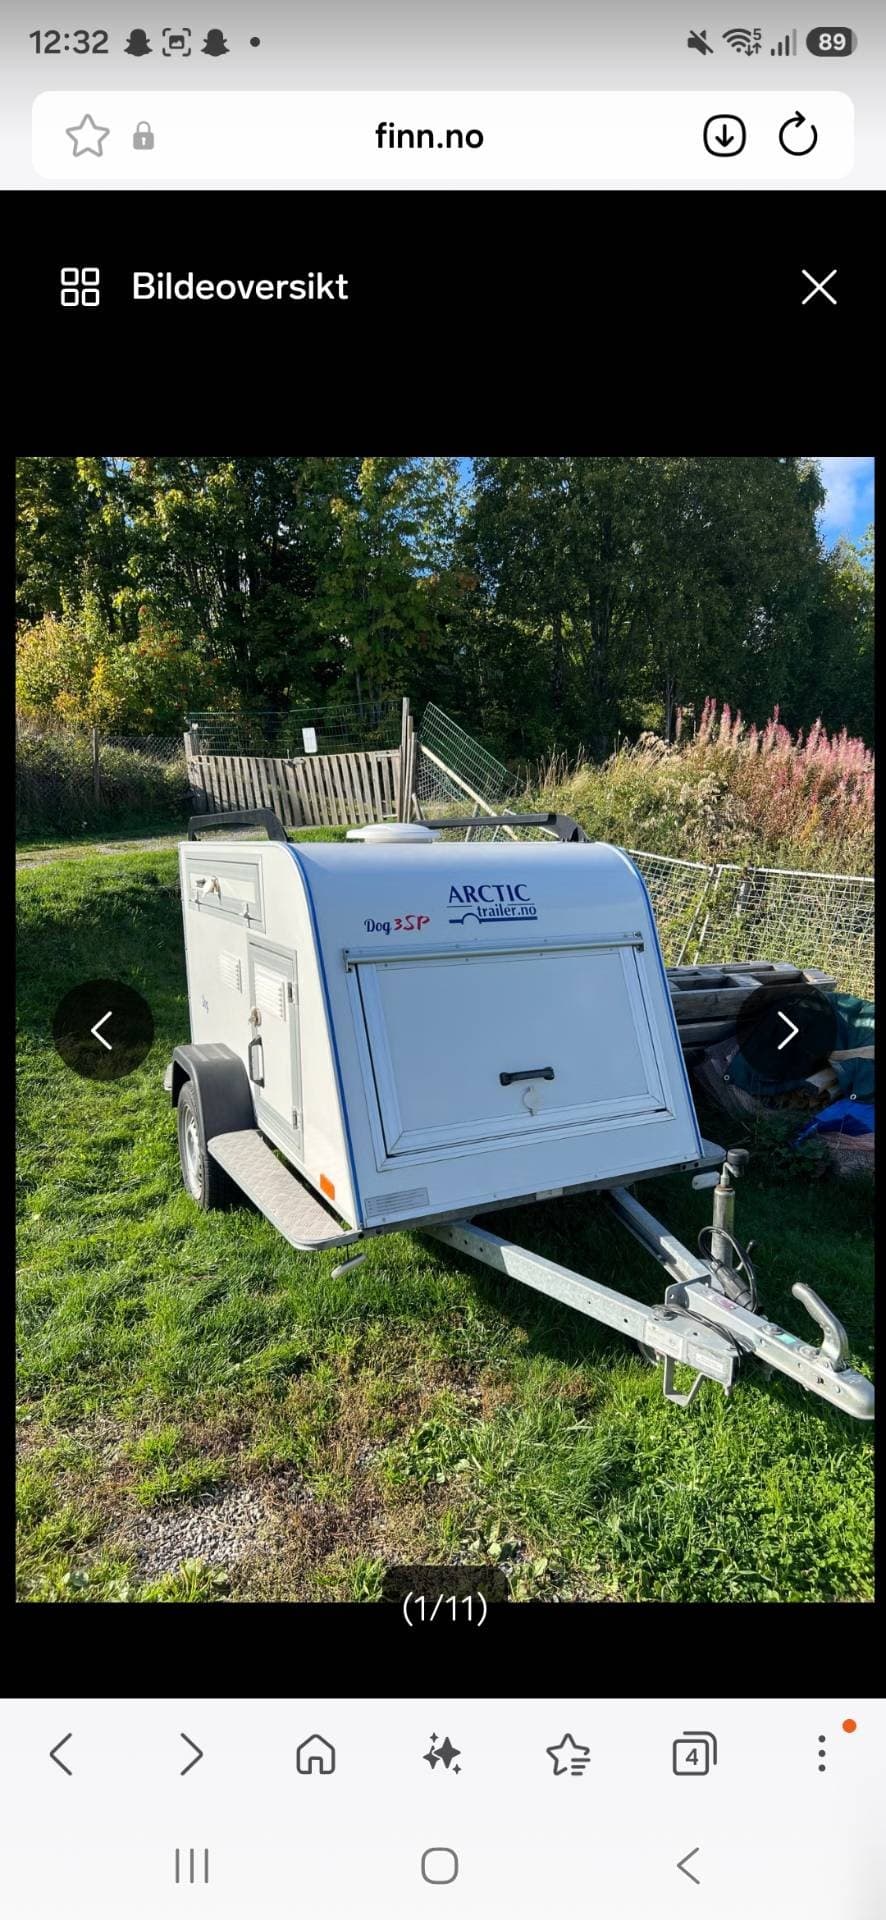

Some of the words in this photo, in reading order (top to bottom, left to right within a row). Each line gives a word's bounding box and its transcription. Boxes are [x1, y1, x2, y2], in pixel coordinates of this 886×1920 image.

[29, 30, 109, 55] 12:32
[818, 33, 847, 51] 89
[375, 122, 485, 150] finn.no
[132, 271, 349, 301] Bildeoversikt
[448, 883, 531, 904] ARCTIC
[477, 903, 537, 918] trailer.no
[364, 918, 392, 935] Dog
[403, 1591, 488, 1627] (1/11)
[685, 1747, 699, 1766] 4
